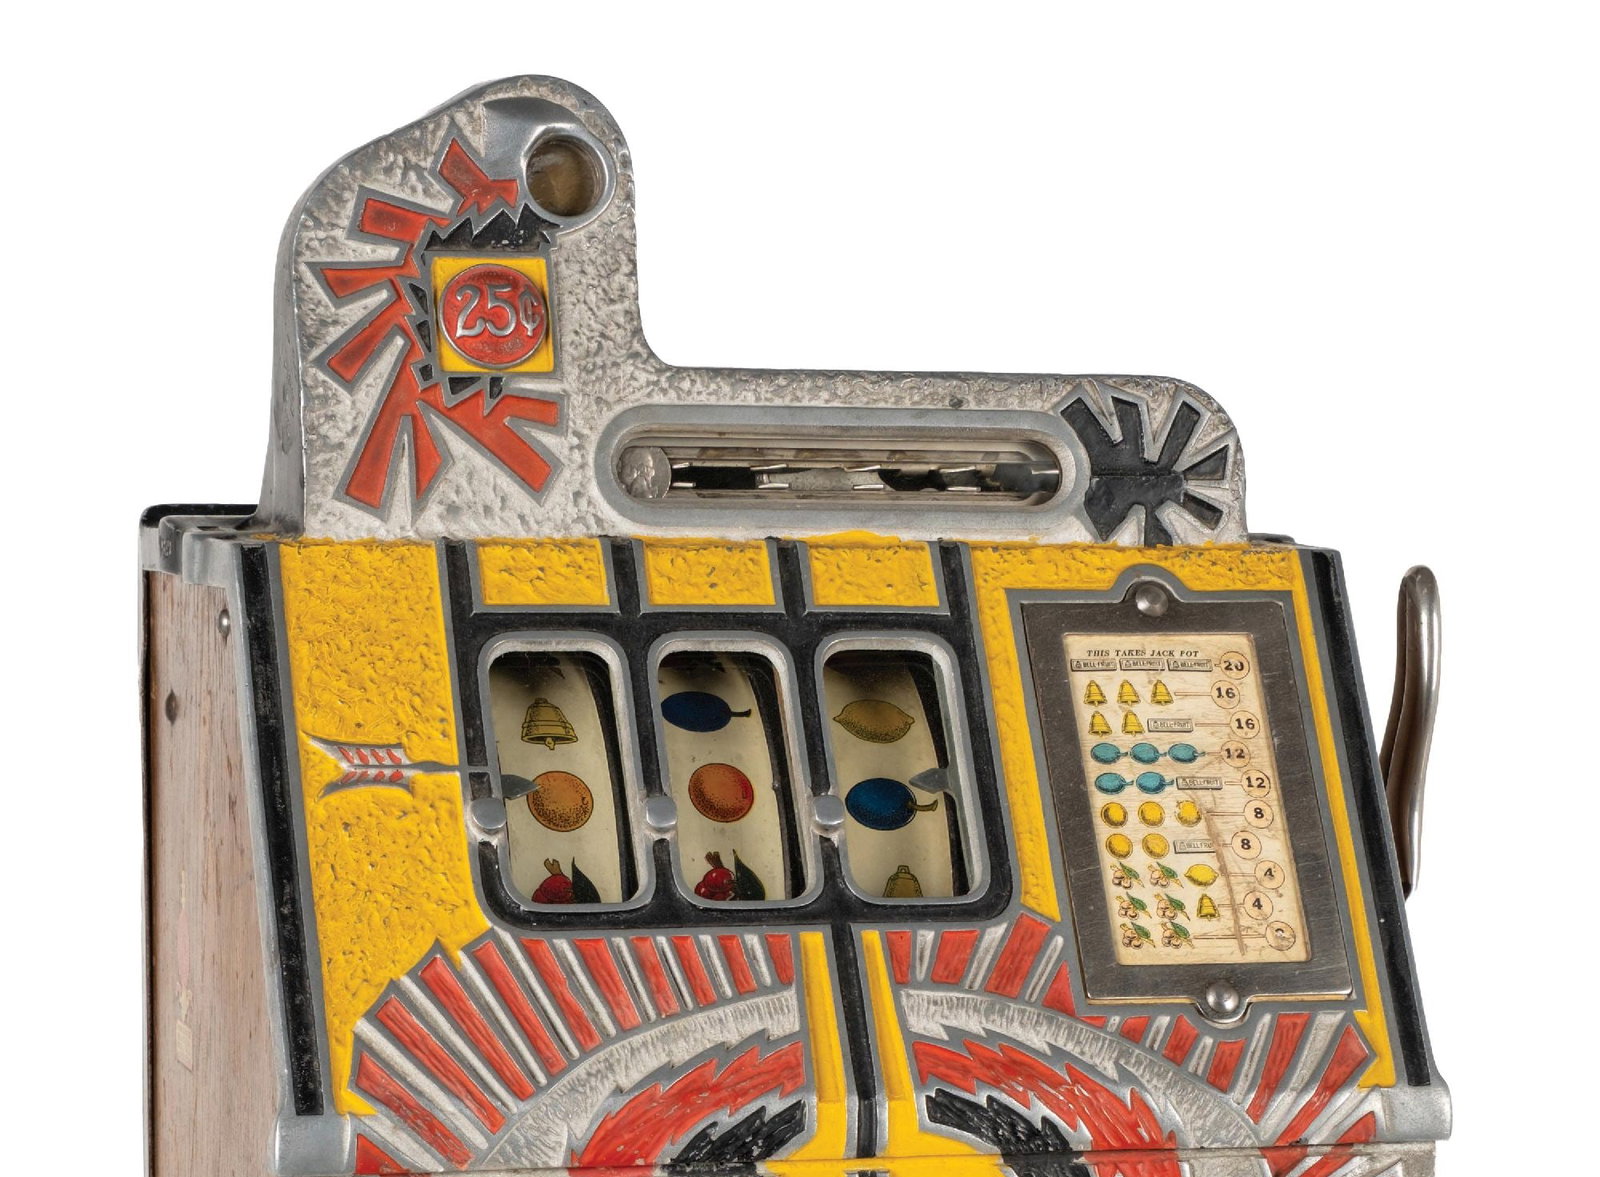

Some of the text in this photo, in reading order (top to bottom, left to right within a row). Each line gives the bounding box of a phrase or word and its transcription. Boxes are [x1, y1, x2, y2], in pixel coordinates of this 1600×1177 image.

[455, 283, 541, 338] 25¢
[1086, 649, 1200, 657] THIS TAKES JACK POT
[1223, 660, 1245, 671] 20
[1215, 686, 1236, 699] 16
[1235, 717, 1255, 730] 16
[1225, 747, 1246, 759] 12
[1245, 776, 1266, 789] 12
[1253, 807, 1264, 819] 8
[1240, 838, 1252, 851] 8
[1252, 897, 1263, 910] 4
